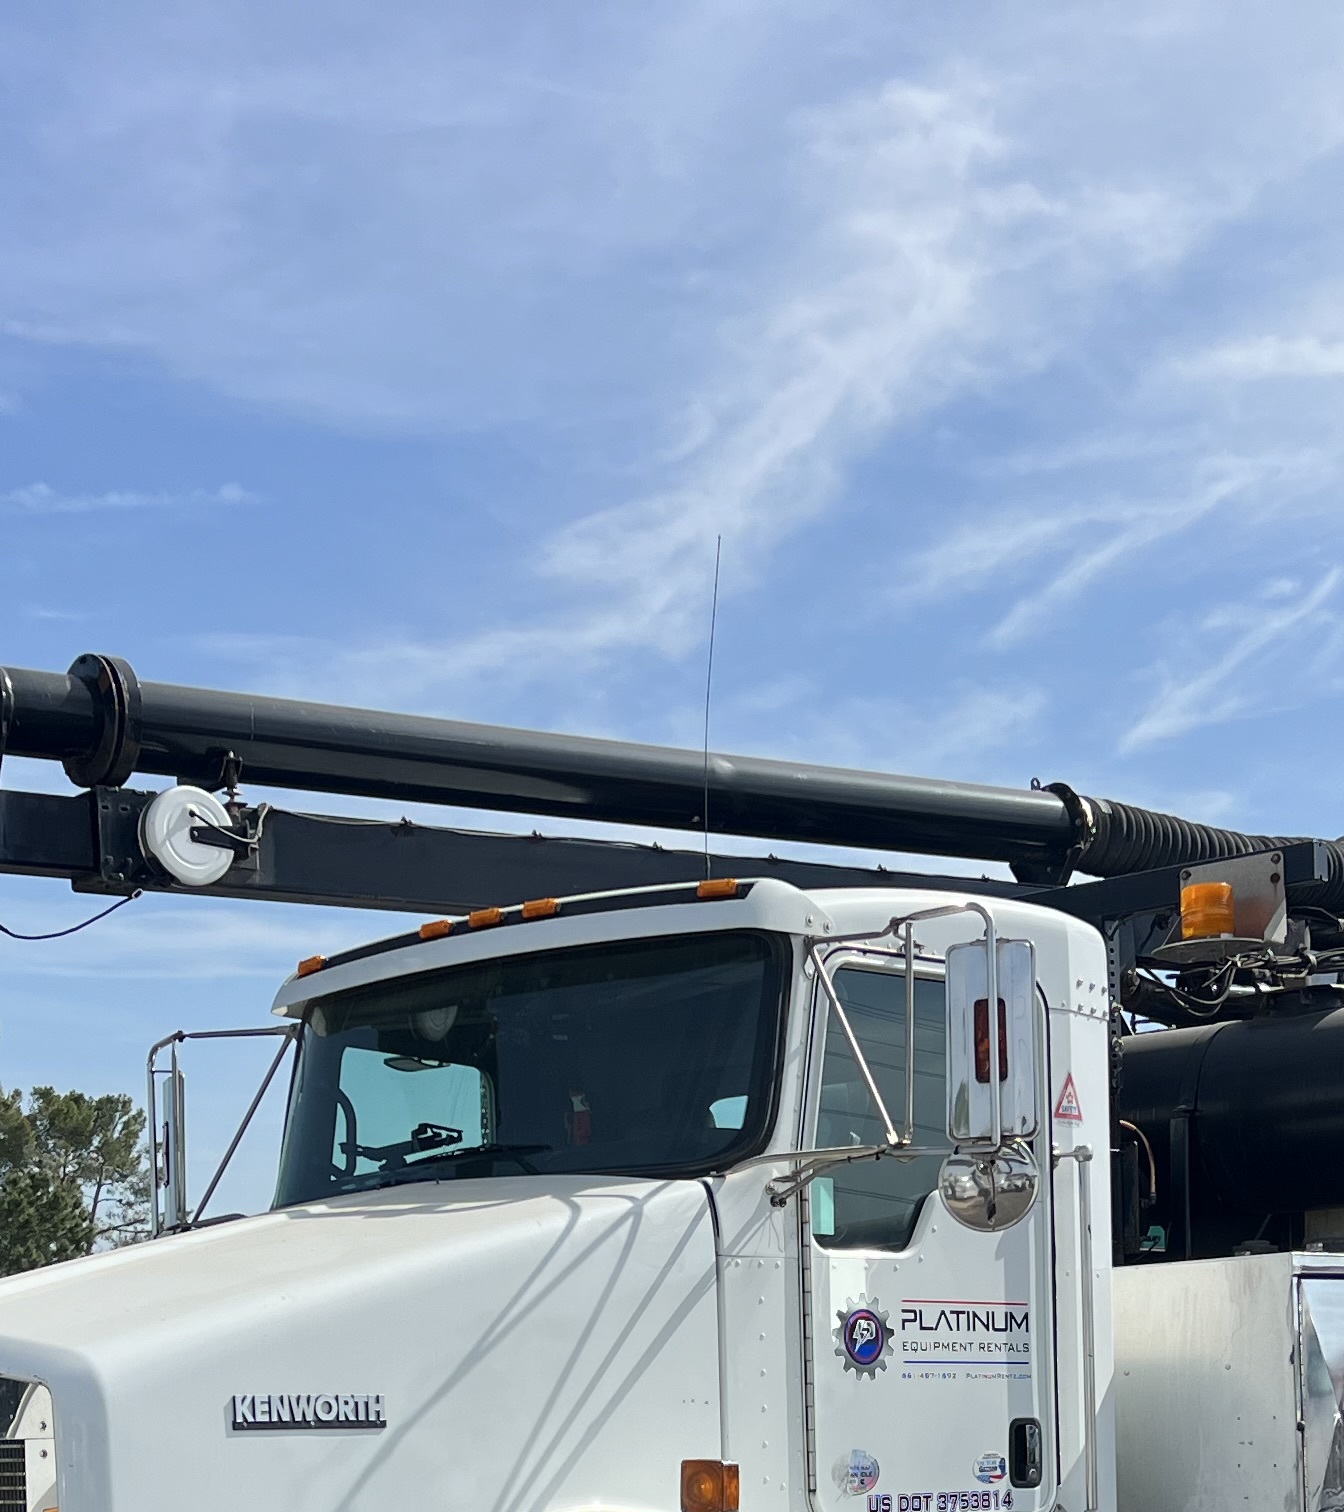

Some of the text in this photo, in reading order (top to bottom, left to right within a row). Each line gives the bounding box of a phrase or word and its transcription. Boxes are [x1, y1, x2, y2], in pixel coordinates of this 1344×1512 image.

[901, 1309, 1029, 1333] PLATINUM
[902, 1341, 1030, 1353] EQUIPMENT RENTALS
[233, 1394, 387, 1423] KENWORTH
[937, 1489, 1013, 1512] 3753814
